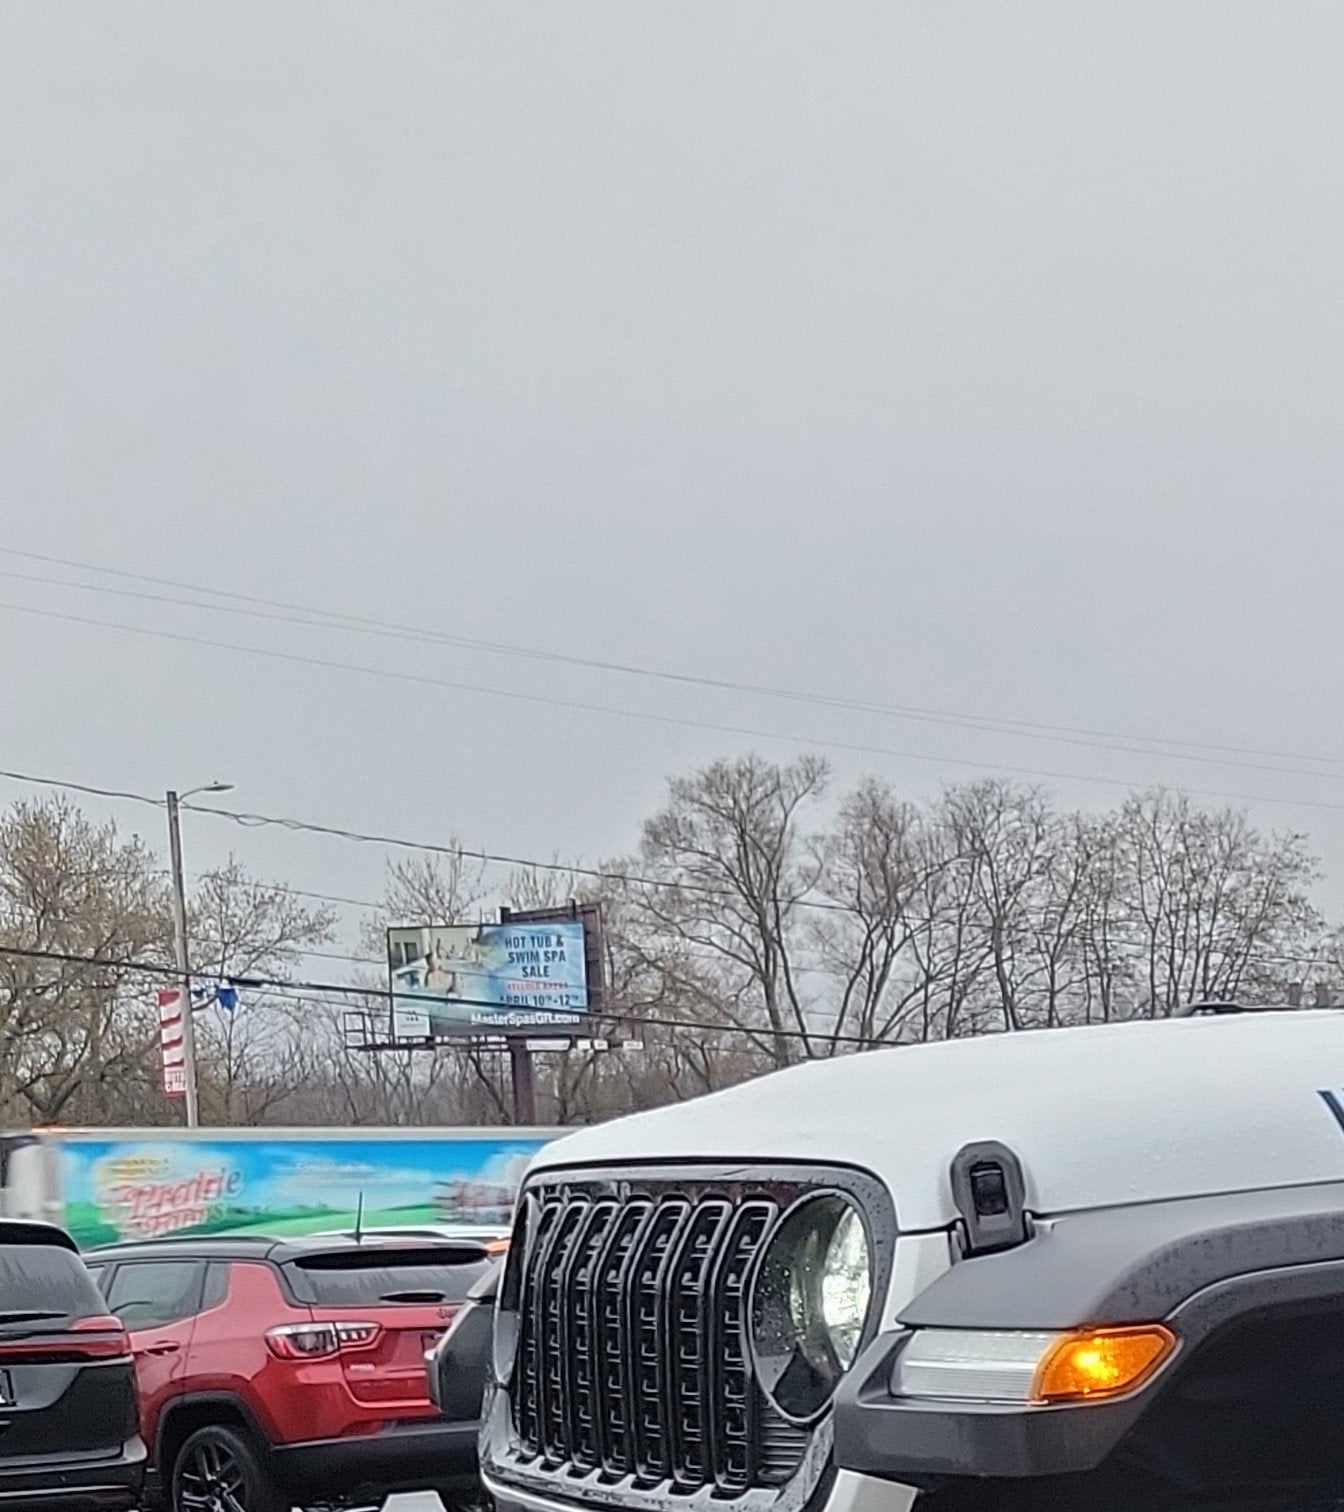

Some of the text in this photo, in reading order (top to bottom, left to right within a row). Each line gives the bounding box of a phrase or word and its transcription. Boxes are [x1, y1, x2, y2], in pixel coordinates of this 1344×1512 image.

[505, 934, 564, 949] HOT TUB &
[508, 950, 566, 964] SWIM SPA
[522, 966, 550, 978] SALE
